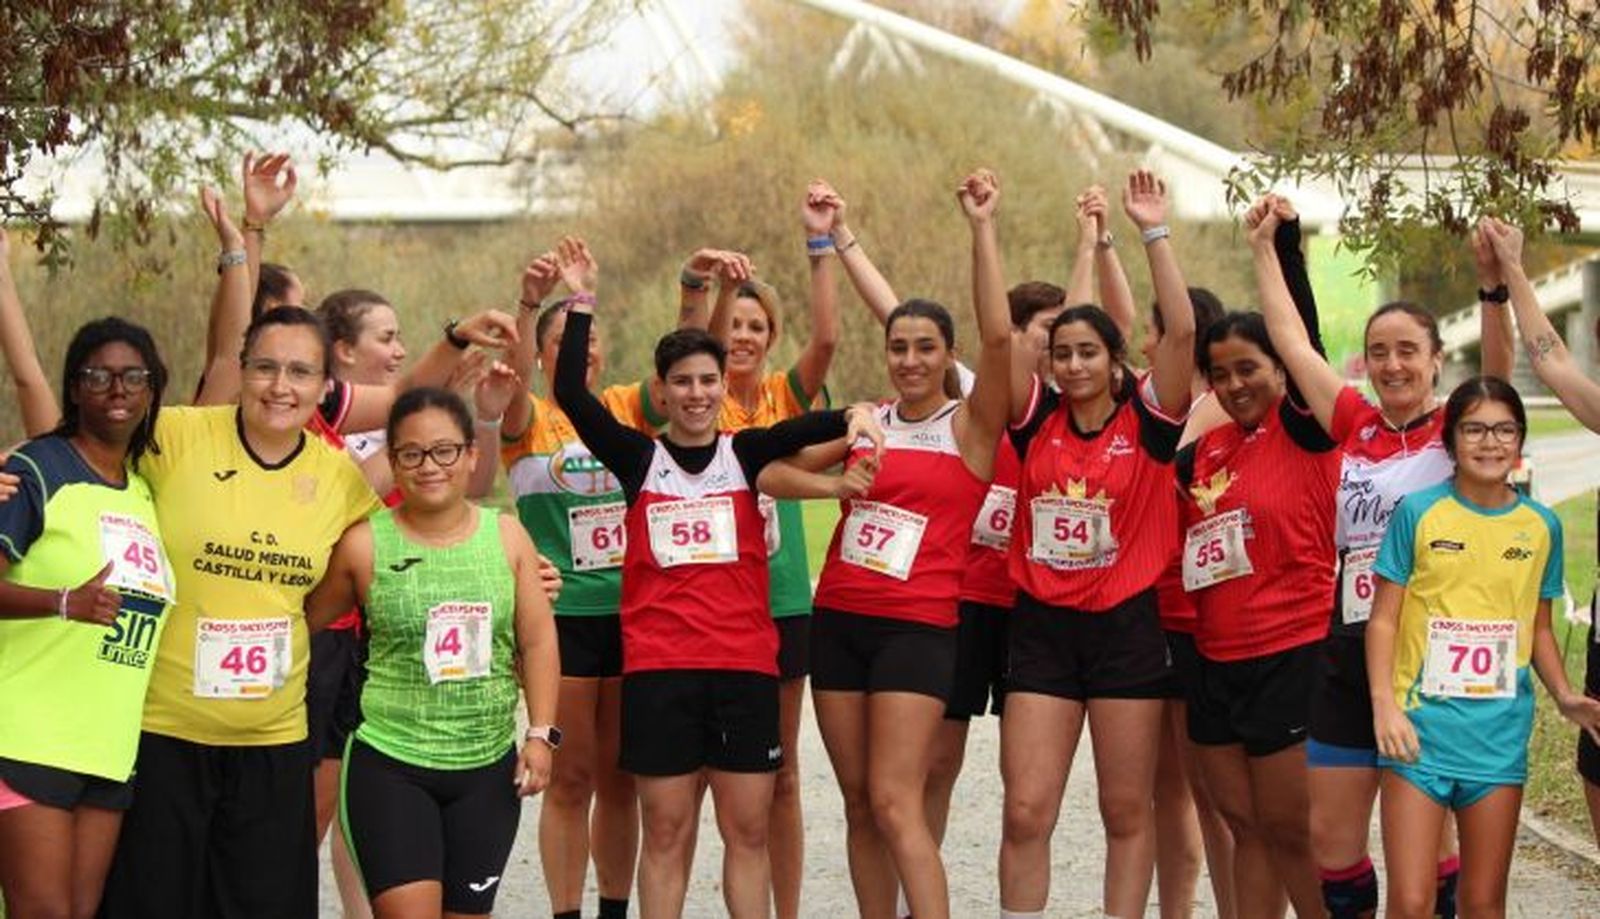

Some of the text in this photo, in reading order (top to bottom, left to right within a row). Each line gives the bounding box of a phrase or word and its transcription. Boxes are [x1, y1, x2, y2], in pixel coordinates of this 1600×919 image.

[592, 524, 623, 550] 61
[671, 521, 711, 546] 58
[857, 523, 896, 551] 57
[1054, 517, 1089, 544] 54
[124, 540, 158, 575] 45
[204, 542, 313, 570] SALUD MENTAL
[1195, 538, 1225, 568] 55
[193, 558, 263, 583] CASTILLA
[269, 571, 279, 583] Y
[201, 620, 289, 633] CROSS INCLUSIVO
[1431, 620, 1515, 634] CROSS INCLUSIVO
[220, 645, 267, 675] 46
[1448, 645, 1492, 676] 70
